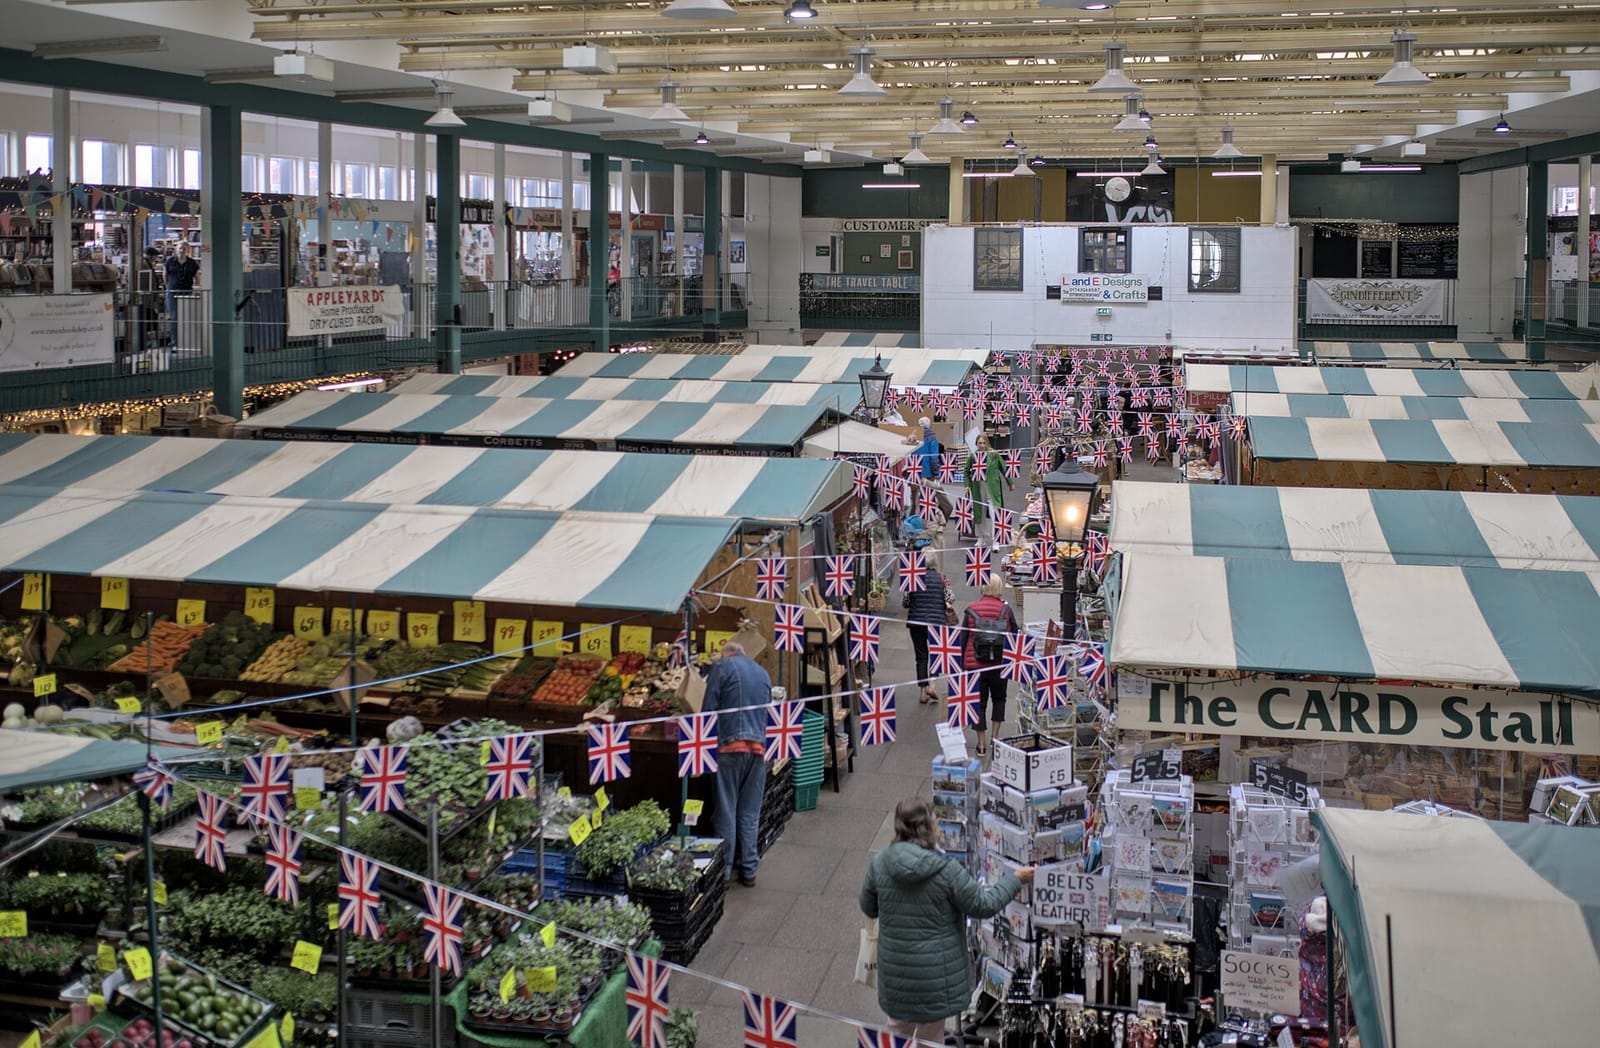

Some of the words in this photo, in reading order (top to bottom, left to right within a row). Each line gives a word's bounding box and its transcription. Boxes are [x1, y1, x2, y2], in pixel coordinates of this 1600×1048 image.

[844, 220, 916, 231] CUSTOMER
[826, 276, 841, 288] THE
[847, 276, 877, 288] TRAVEL
[882, 276, 908, 289] TABLE
[1062, 276, 1070, 286] L
[1071, 276, 1090, 286] and
[1092, 277, 1100, 286] E
[1102, 277, 1142, 289] Designs
[306, 289, 385, 306] APPLEYARDS
[1103, 289, 1111, 299] &
[1112, 289, 1146, 299] Crafts
[1340, 289, 1413, 302] GINDIFFERENT
[341, 304, 375, 316] Produced
[309, 319, 328, 330] DRY
[329, 317, 354, 329] CURED
[357, 315, 383, 327] BACON
[669, 335, 701, 343] COOKED
[483, 436, 543, 447] CORBETTS
[618, 443, 639, 452] HIGH
[640, 445, 666, 454] CLASS
[723, 448, 761, 457] POULTRY
[1147, 681, 1238, 728] The
[1257, 687, 1419, 736] CARD
[1441, 695, 1575, 746] Stall
[994, 744, 1001, 760] 5
[1003, 749, 1025, 765] CARDS
[1031, 755, 1040, 769] 5
[1044, 753, 1066, 763] CARDS
[1004, 765, 1017, 782] £5
[1134, 757, 1146, 779] 5
[1255, 764, 1268, 785] 5
[1050, 769, 1065, 784] £5
[1047, 873, 1095, 891] BELTS
[1034, 904, 1090, 924] LEATHER
[1224, 953, 1290, 979] SOCKS
